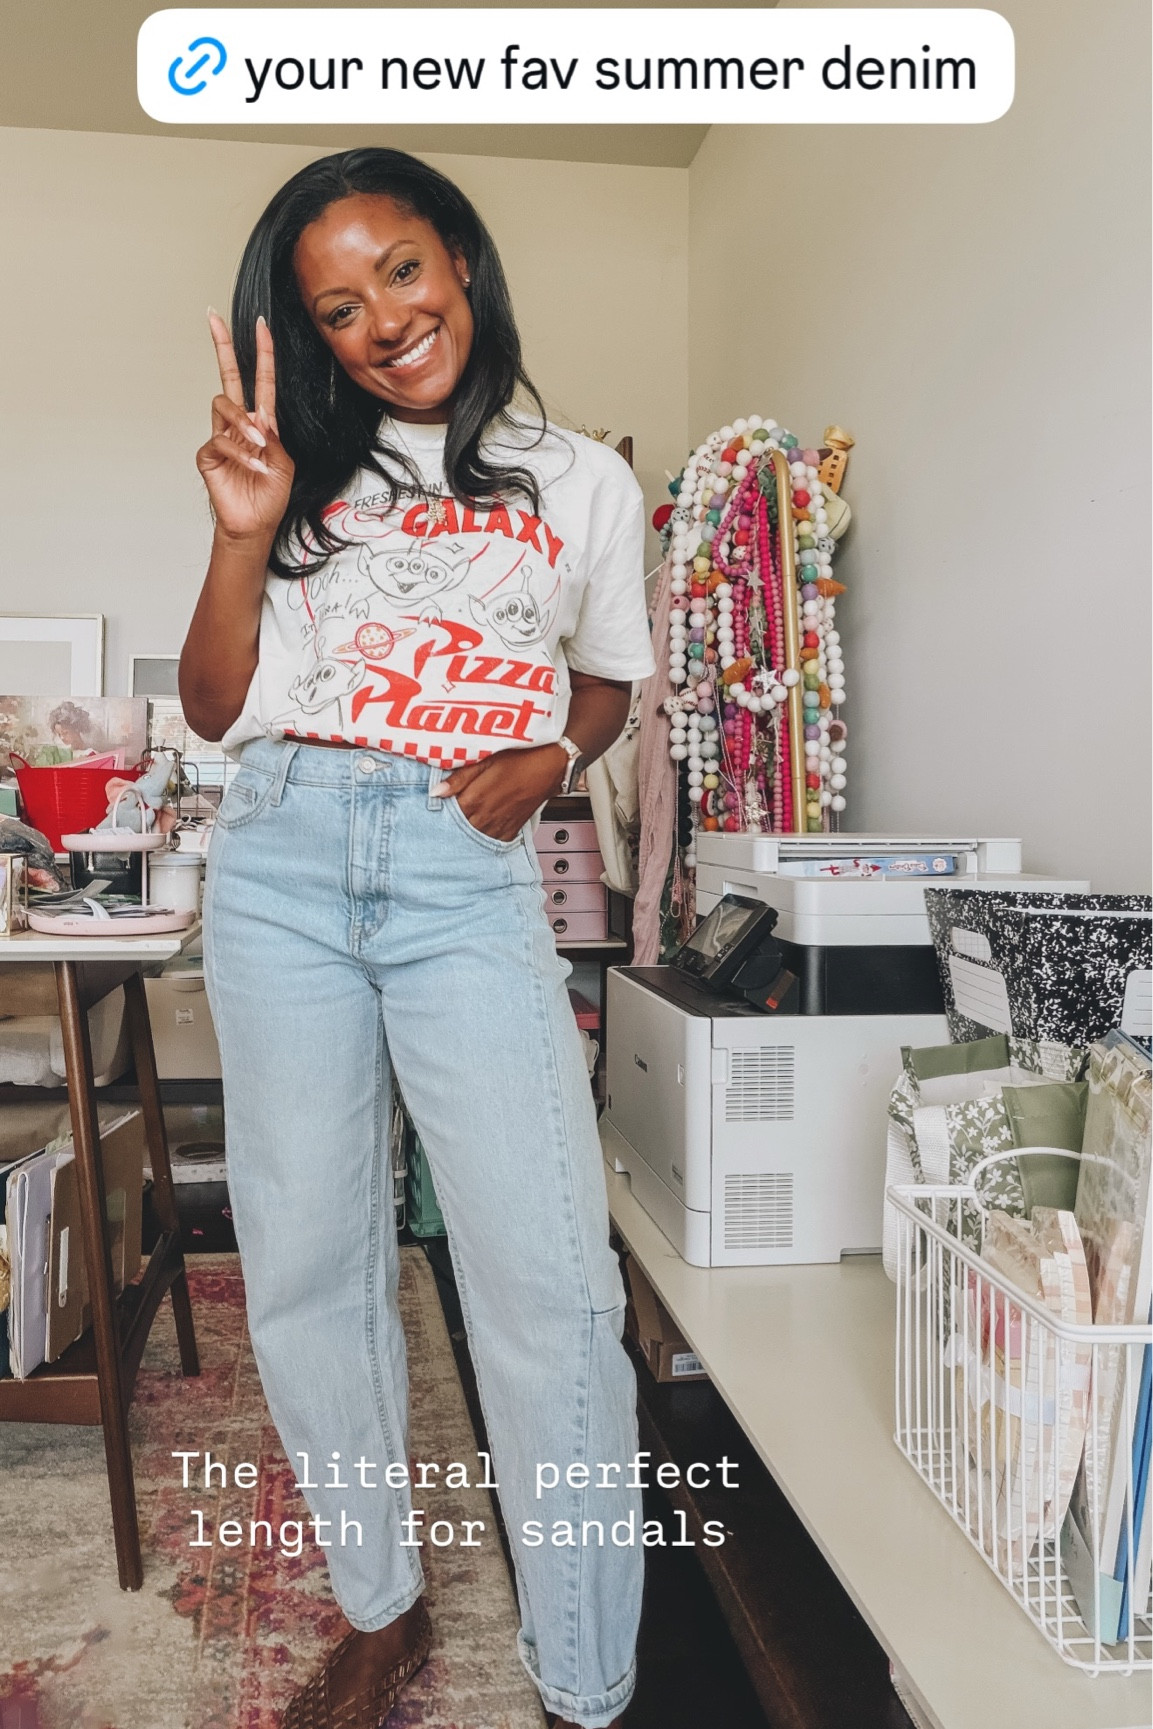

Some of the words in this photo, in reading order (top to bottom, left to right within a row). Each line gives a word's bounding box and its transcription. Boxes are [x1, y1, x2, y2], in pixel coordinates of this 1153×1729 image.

[401, 495, 564, 568] GALAXY
[399, 615, 556, 695] Pizza
[336, 659, 552, 742] Planet
